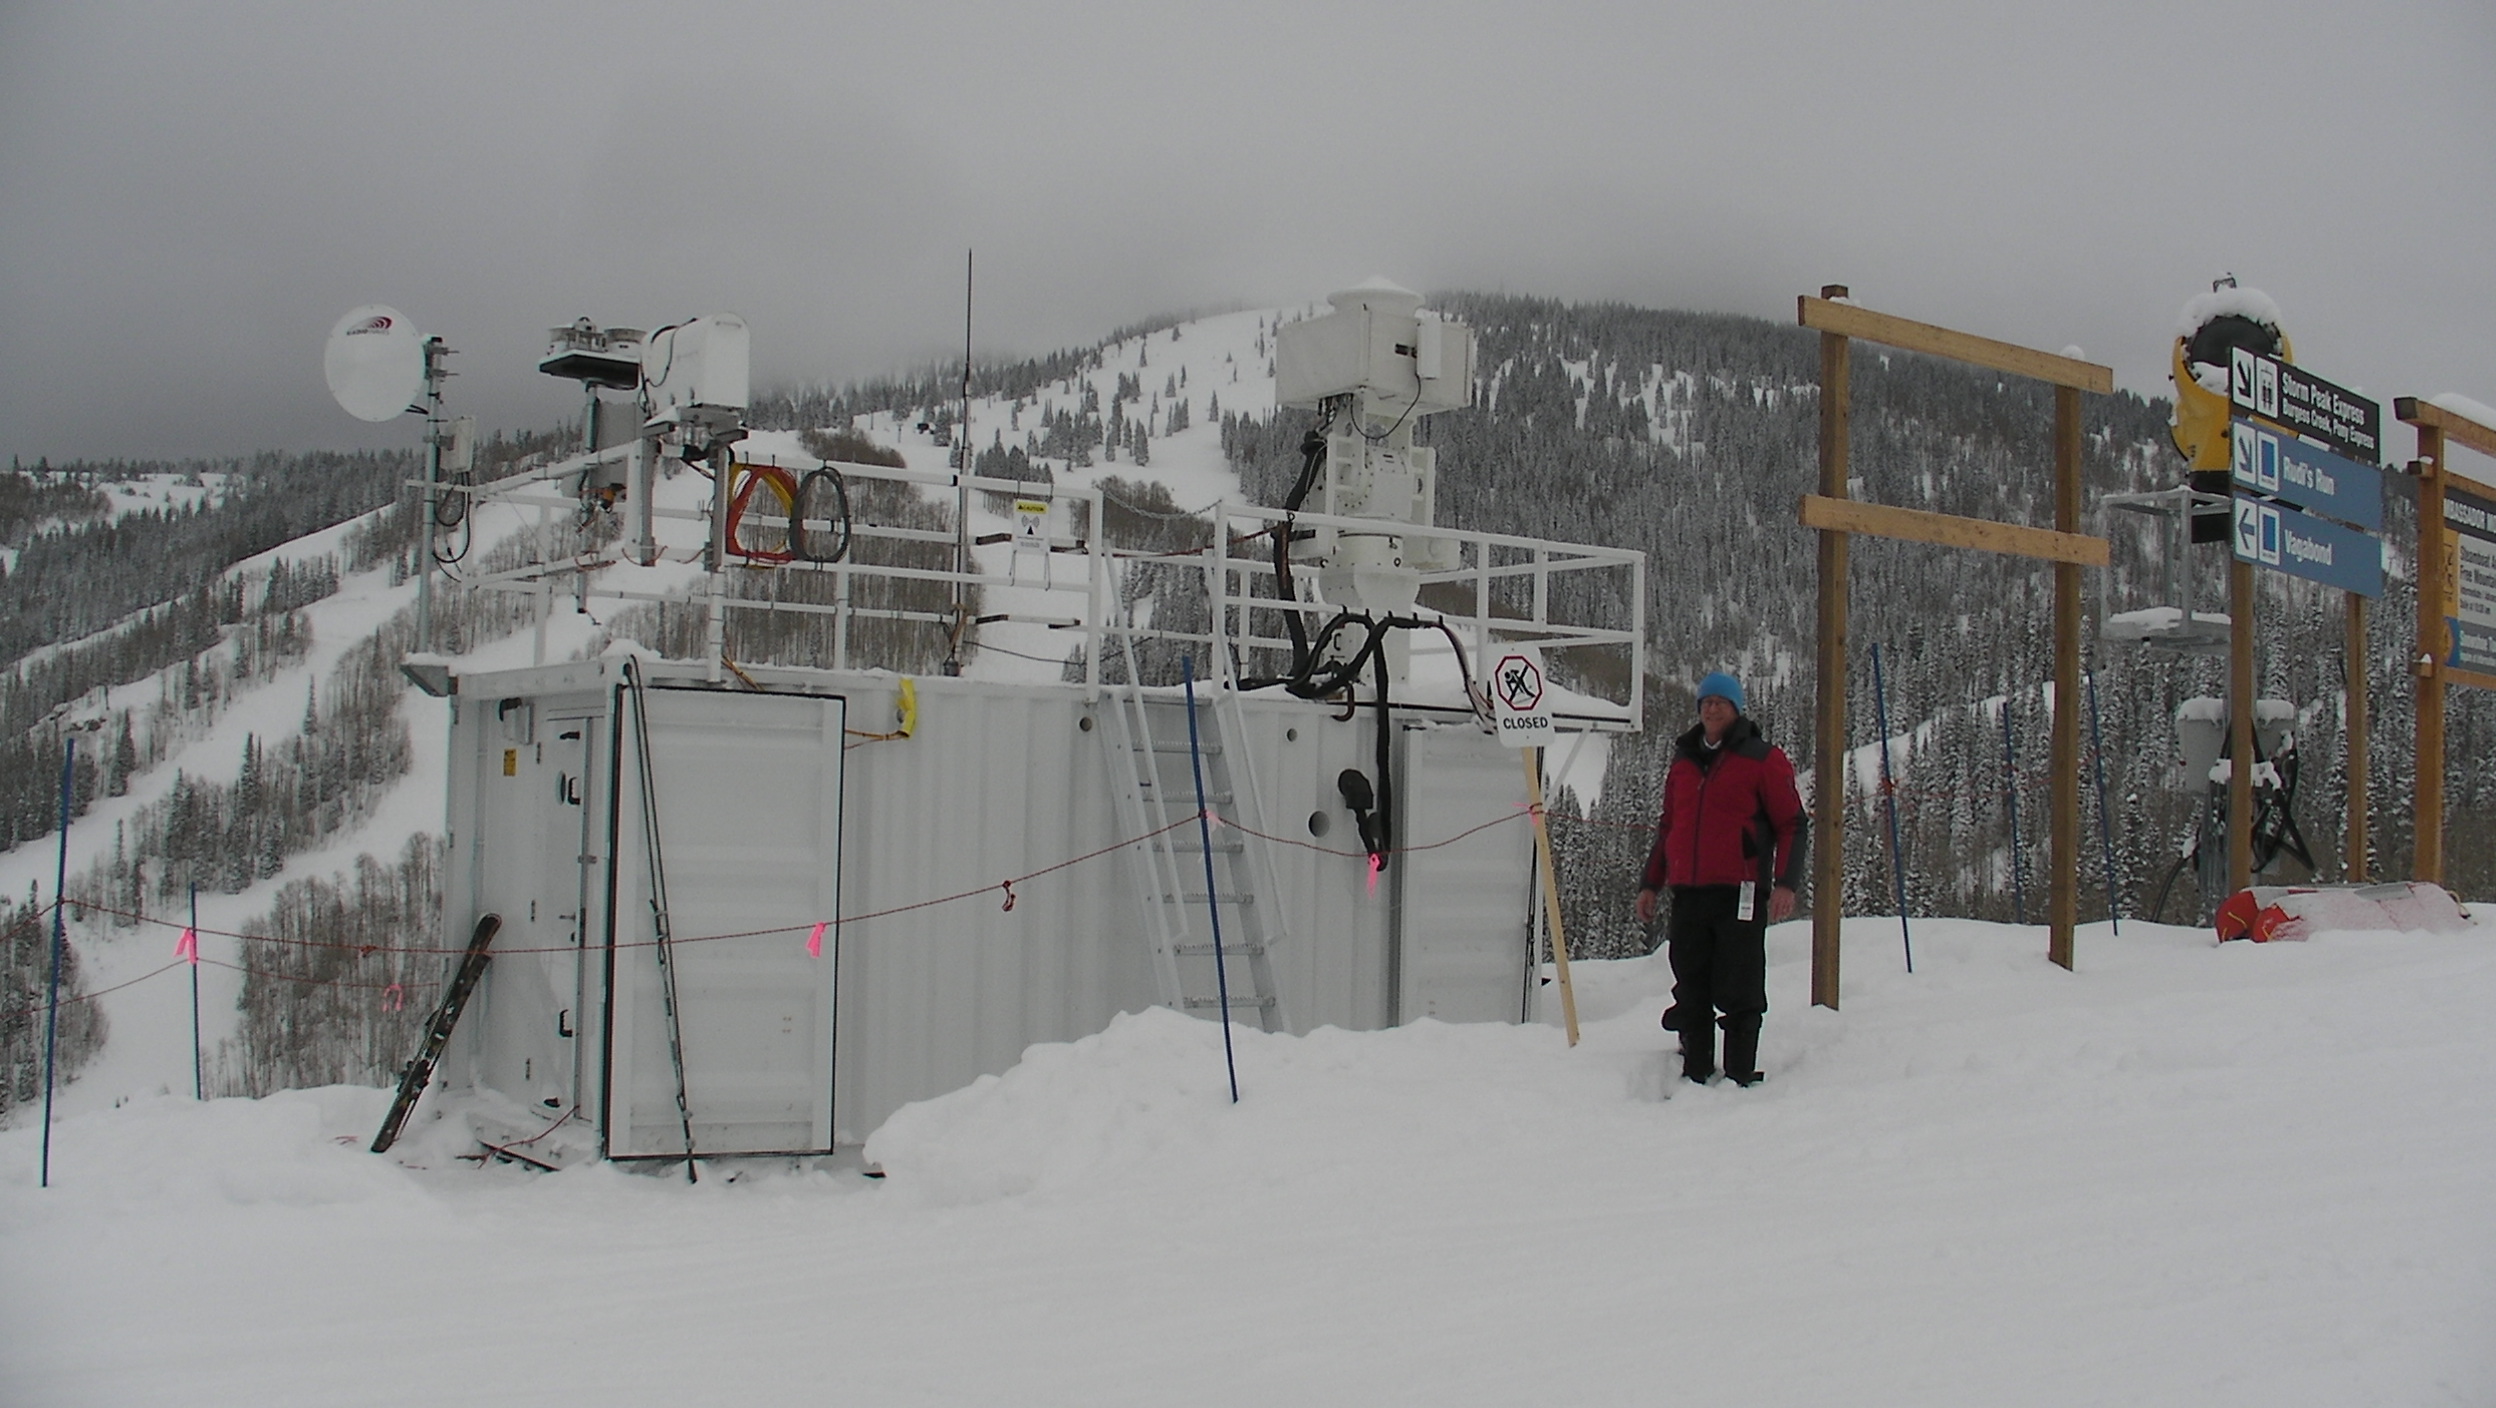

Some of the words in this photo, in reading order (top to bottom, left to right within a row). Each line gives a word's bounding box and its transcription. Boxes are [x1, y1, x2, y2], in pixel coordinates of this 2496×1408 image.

[2282, 372, 2309, 402] Storm
[2311, 384, 2332, 412] Peak
[2333, 394, 2365, 425] Express
[2283, 397, 2310, 424] Burgess
[2311, 410, 2332, 436] Creek,
[2333, 418, 2349, 443] Pony
[2350, 425, 2375, 449] Express
[2283, 456, 2314, 489] Rudi's
[2316, 468, 2335, 496] Run
[2284, 529, 2332, 566] Vagabond
[1503, 717, 1548, 730] CLOSED
